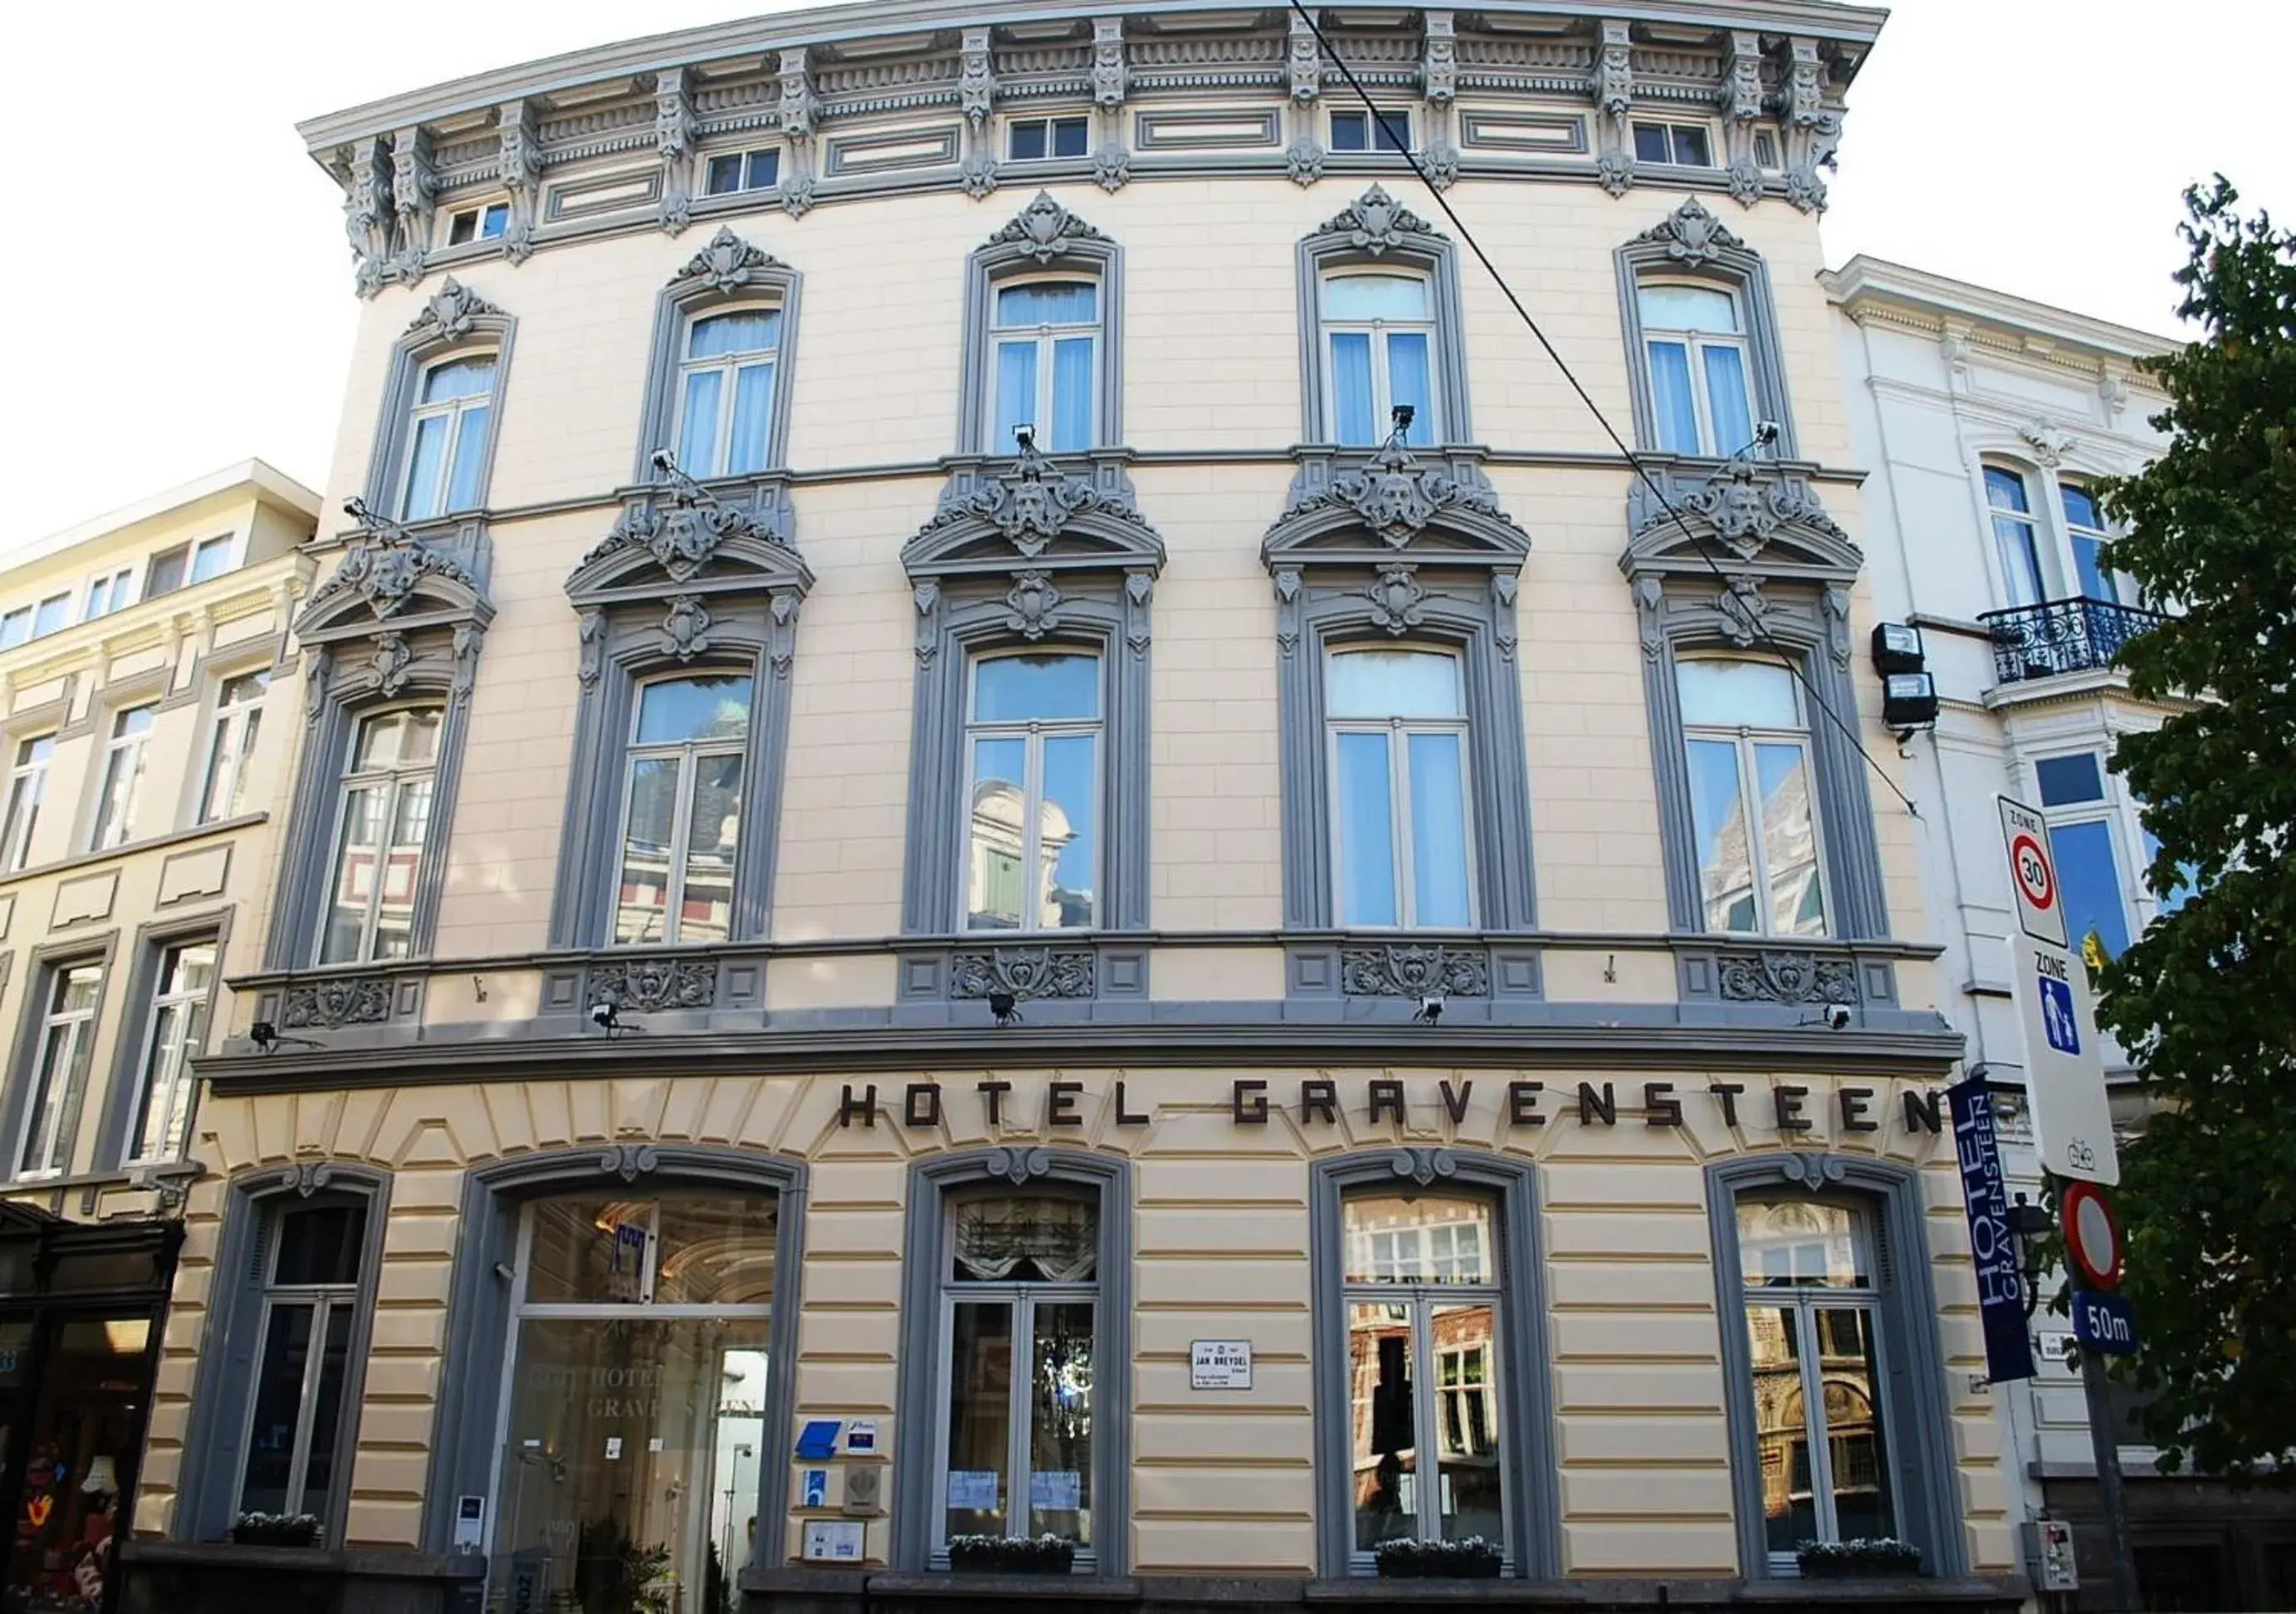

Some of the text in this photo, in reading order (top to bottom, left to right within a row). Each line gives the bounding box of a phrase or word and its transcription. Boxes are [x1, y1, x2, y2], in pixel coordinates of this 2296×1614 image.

[2009, 810, 2037, 834] ZONE
[2022, 857, 2044, 887] 30
[2035, 951, 2069, 981] ZONE
[839, 1079, 1944, 1134] HOTEL GRAVENSTEEN
[1956, 1098, 2005, 1306] HOTEL
[1972, 1094, 2020, 1300] GRAVENSTEEN
[2087, 1305, 2130, 1342] 50m
